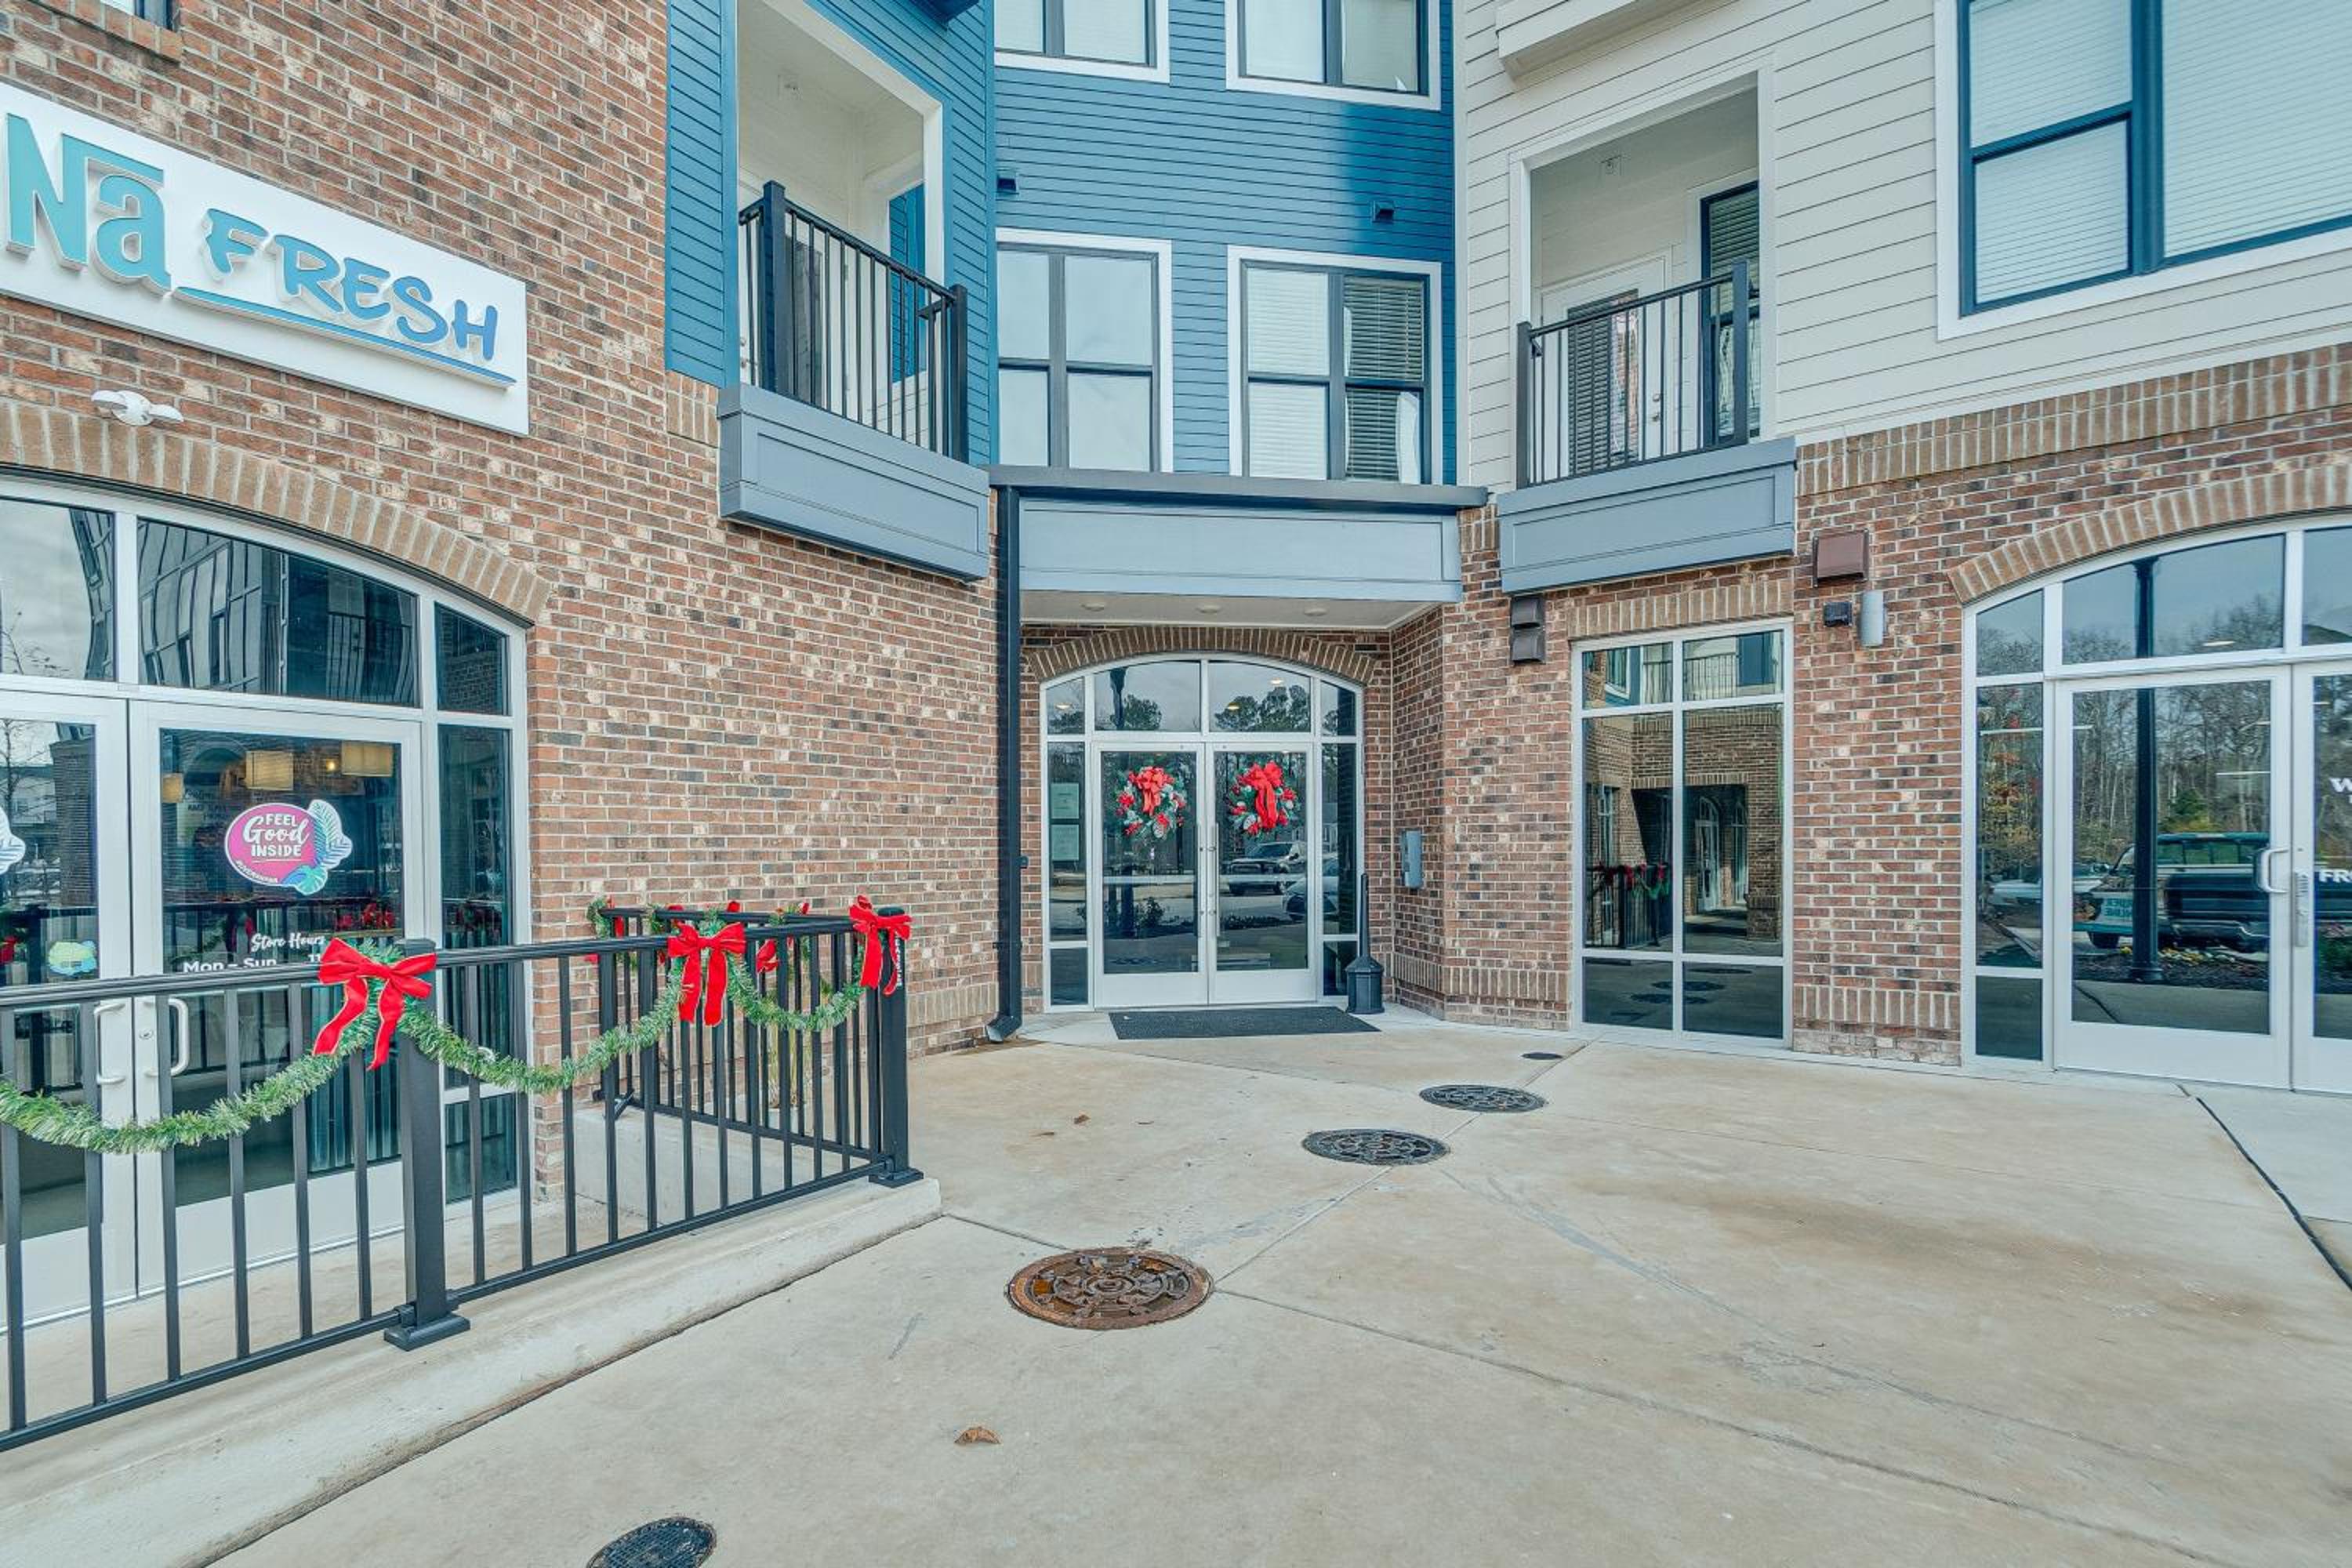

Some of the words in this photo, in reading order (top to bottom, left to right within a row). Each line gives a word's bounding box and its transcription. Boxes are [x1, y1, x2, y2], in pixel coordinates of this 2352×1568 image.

[204, 208, 498, 361] FRESH
[266, 813, 297, 827] FEEL
[243, 815, 310, 844] Good
[251, 844, 302, 857] INSIDE
[251, 932, 286, 952] Store
[288, 932, 326, 949] Hours
[183, 960, 224, 973] Mon
